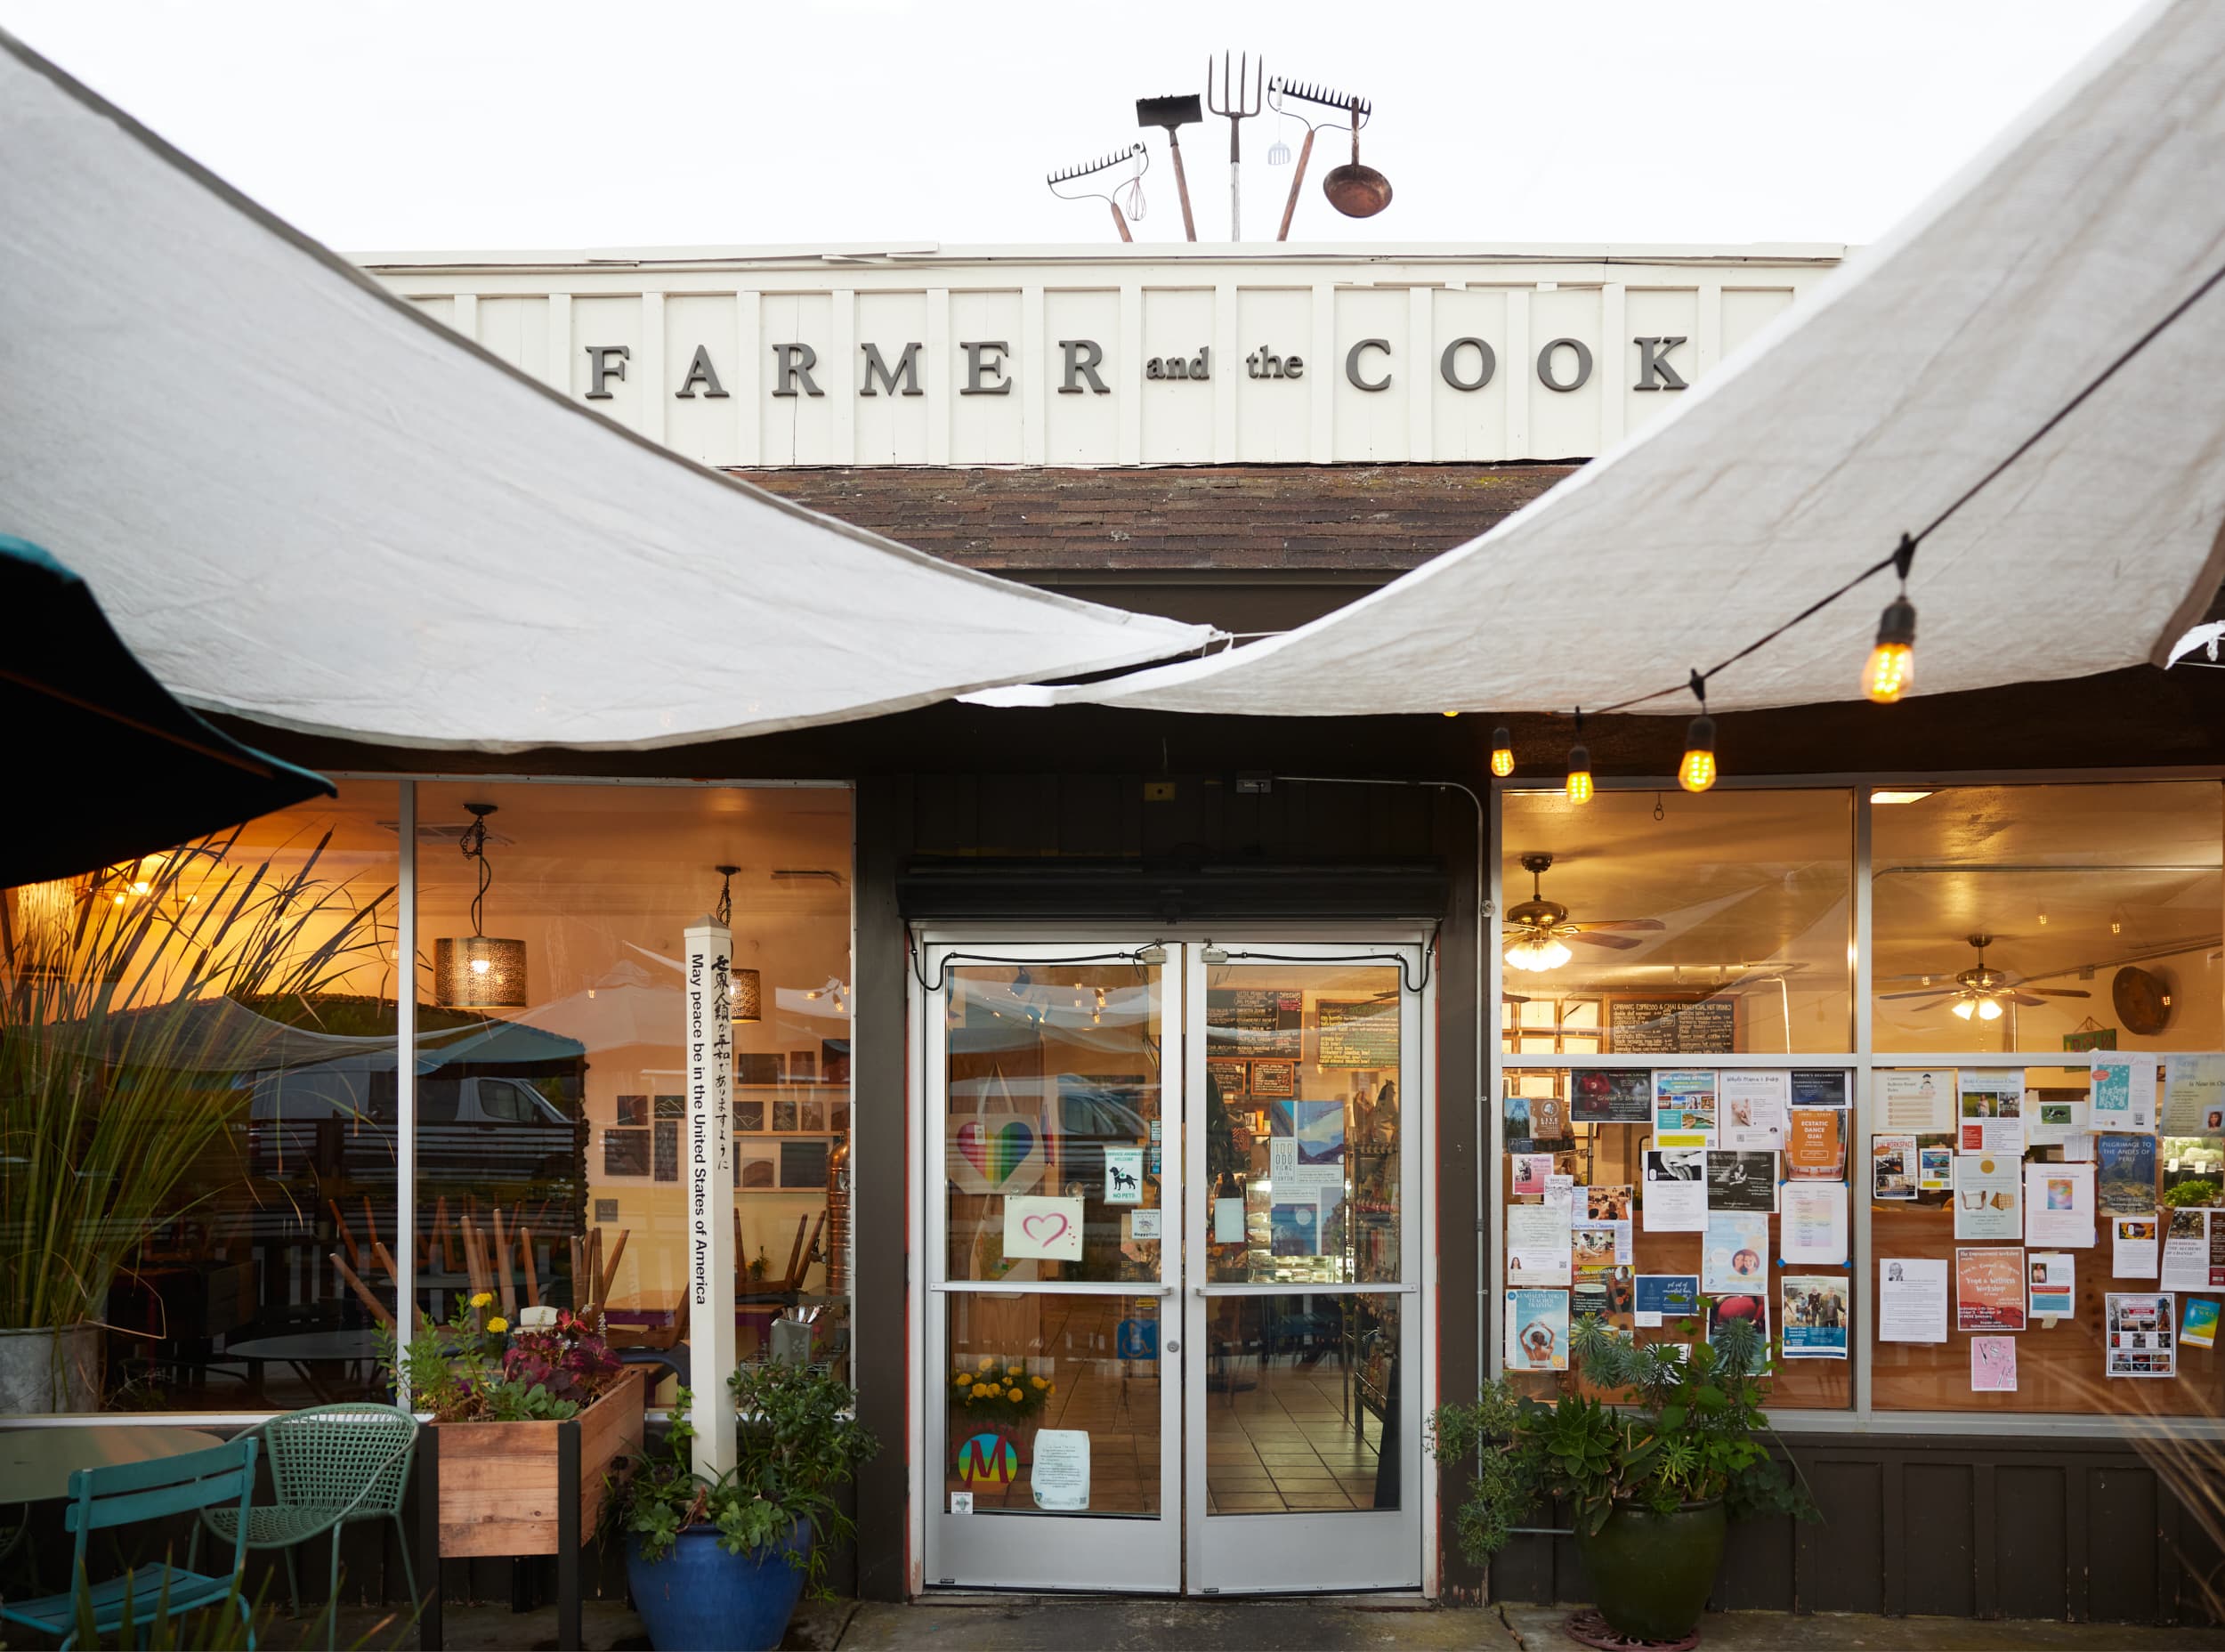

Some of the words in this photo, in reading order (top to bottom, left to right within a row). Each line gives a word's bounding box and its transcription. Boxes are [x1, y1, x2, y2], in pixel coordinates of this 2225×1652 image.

[585, 339, 1111, 400] FARMER
[1146, 345, 1210, 380] and
[1246, 344, 1304, 378] the
[1346, 336, 1690, 393] COOK
[690, 953, 704, 986] May
[690, 992, 702, 1038] peace
[692, 1043, 705, 1062] be
[693, 1066, 706, 1080] in
[710, 954, 731, 1170] 世界人類が平和でありますように
[693, 1085, 706, 1109] the
[693, 1113, 707, 1163] United
[693, 1168, 707, 1216] States
[694, 1220, 708, 1235] of
[695, 1239, 708, 1305] America
